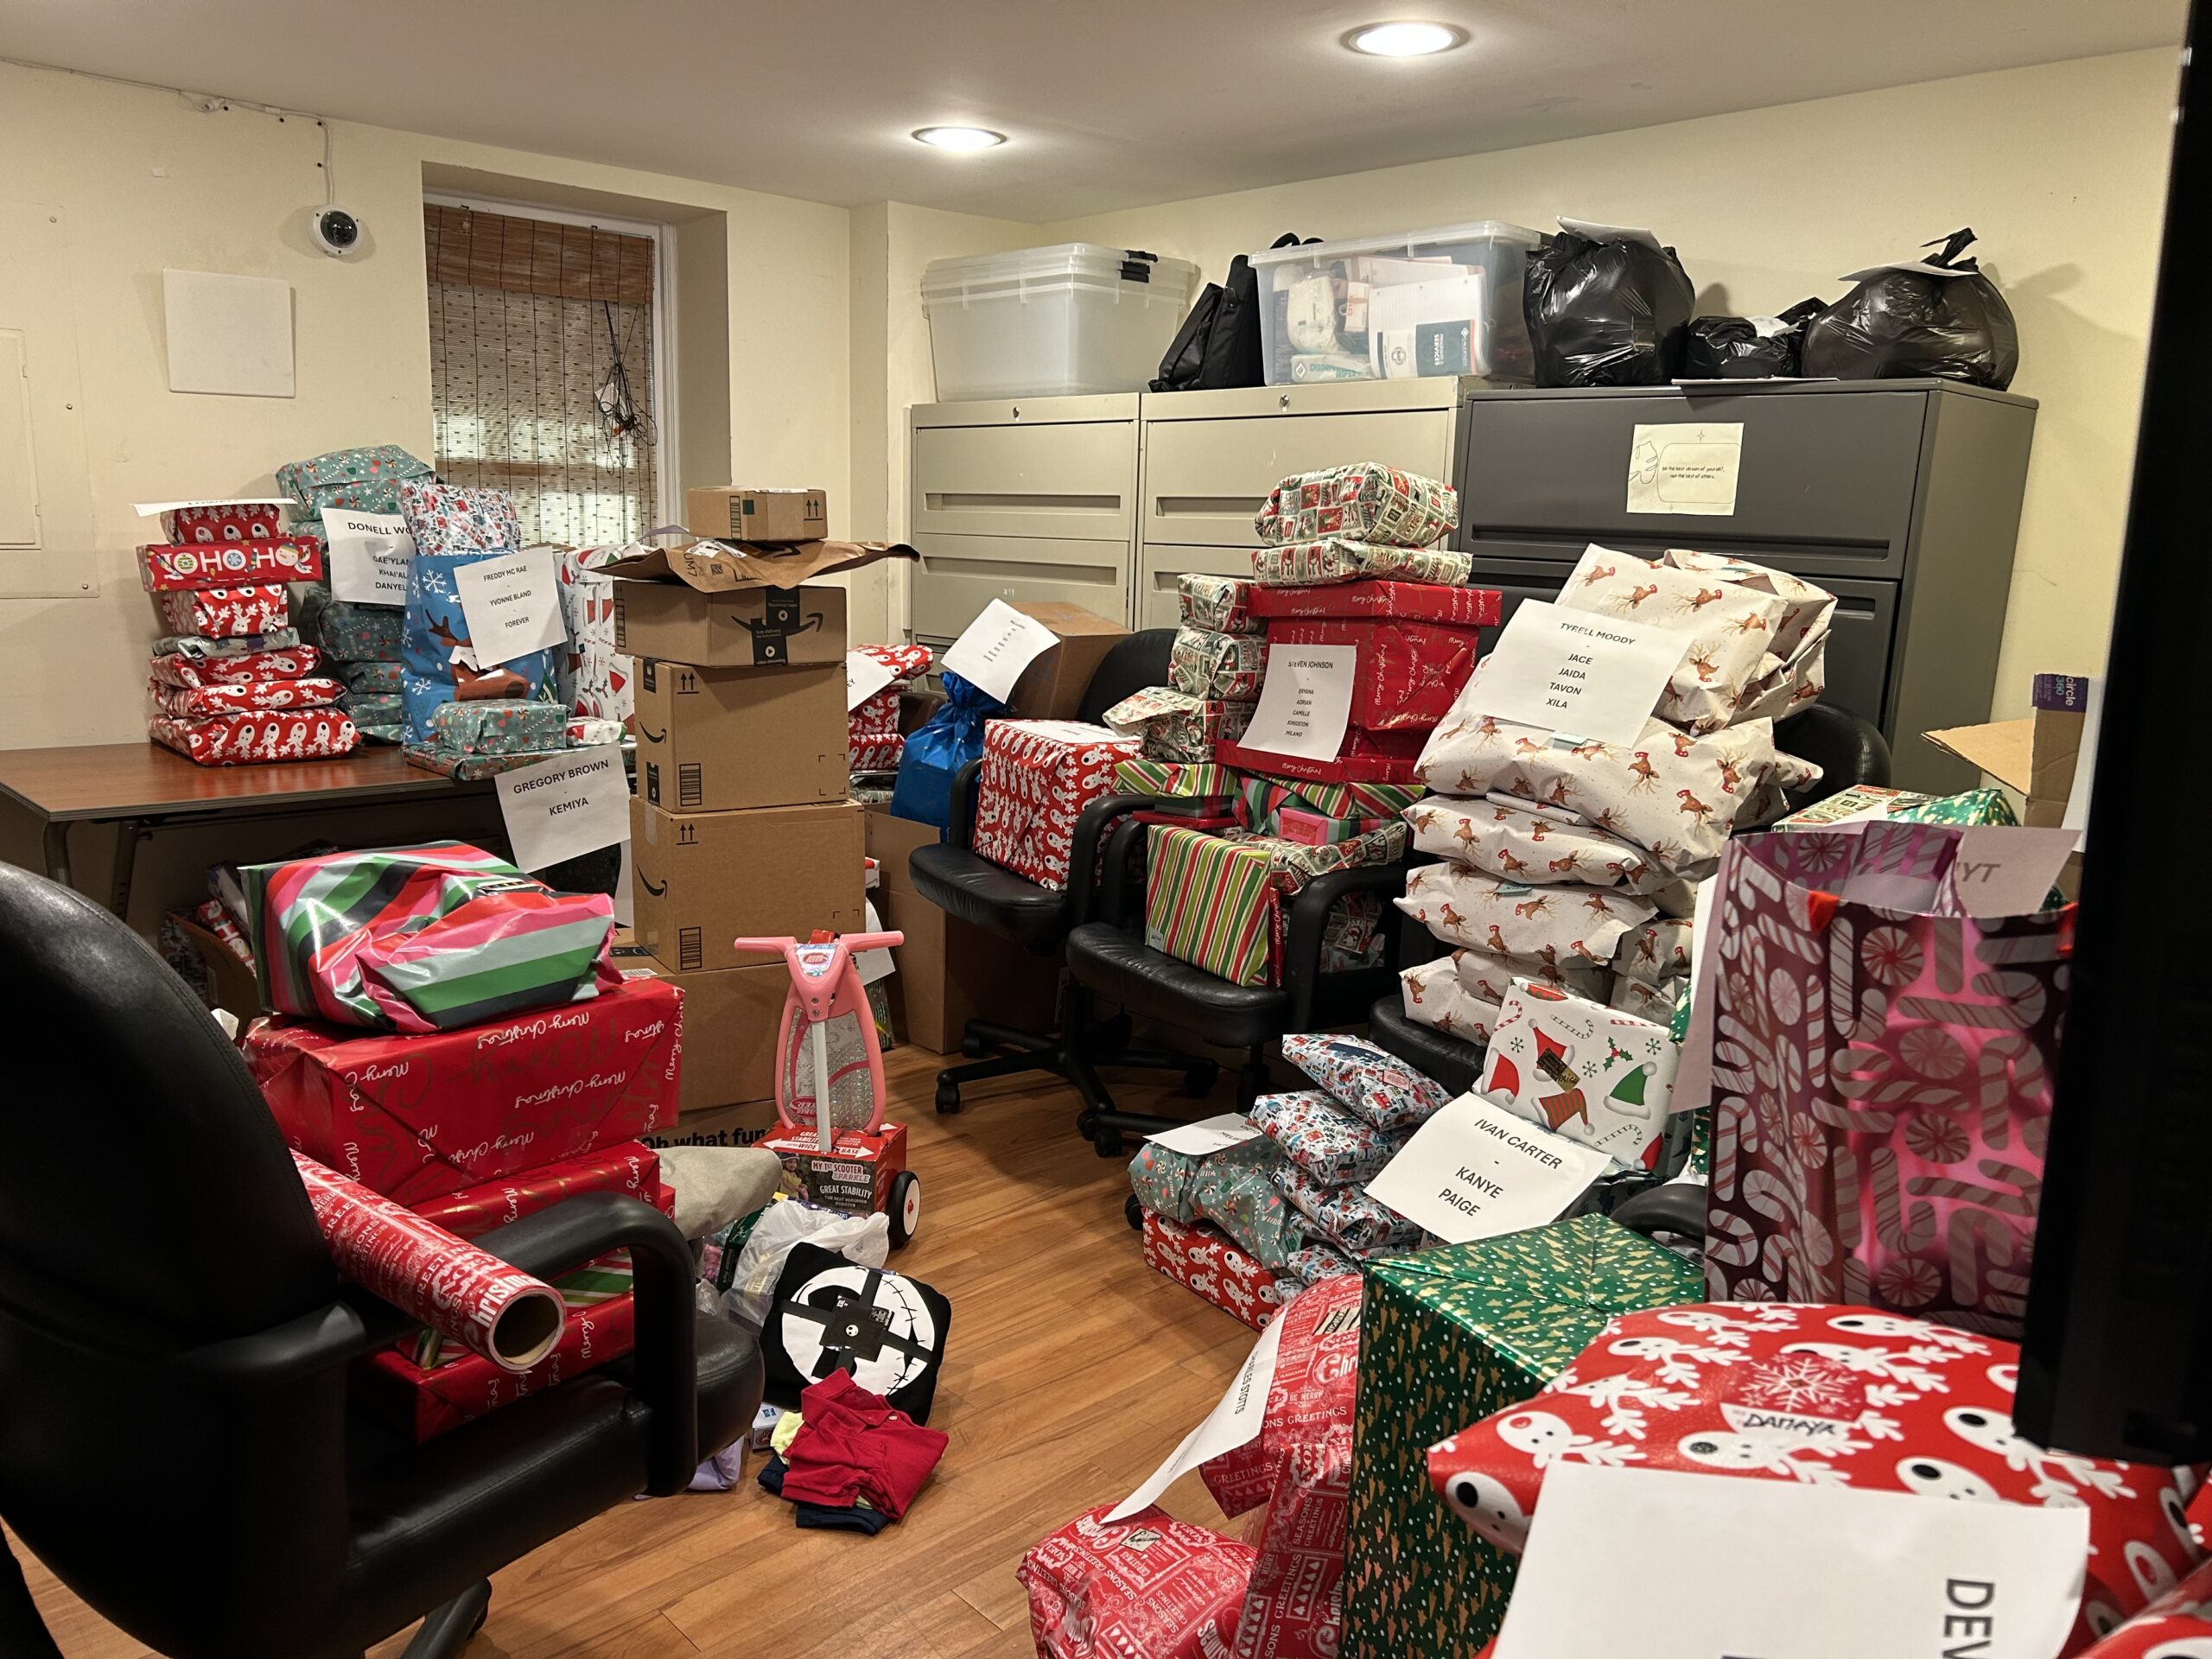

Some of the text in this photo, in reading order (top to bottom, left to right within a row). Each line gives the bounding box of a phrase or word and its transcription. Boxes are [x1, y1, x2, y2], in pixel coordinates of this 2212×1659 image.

[347, 522, 392, 536] DONELL
[483, 565, 528, 582] FREDDY MC RAE
[490, 590, 532, 607] YVONNE BLAND
[505, 616, 530, 629] FOREVER
[1560, 622, 1637, 645] TYRELL MOODY
[1308, 661, 1333, 670] JOHNSON
[1567, 653, 1593, 665] JACE
[1558, 667, 1586, 680] JAIDA
[1375, 679, 1384, 706] Merry
[1548, 681, 1582, 696] TAVON
[2056, 677, 2065, 696] 360
[2065, 677, 2077, 707] circle
[1545, 697, 1567, 709] XILA
[513, 760, 609, 794] GREGORY BROWN
[549, 797, 589, 817] KEMIYA
[1957, 862, 2001, 883] YT
[477, 1012, 590, 1050] Merry Christmas
[514, 1071, 626, 1109] Merry Christmas
[491, 1132, 535, 1150] Merry
[640, 1135, 670, 1148] Oh
[674, 1129, 728, 1147] what
[1474, 1118, 1563, 1169] IVAN CARTER
[624, 1155, 640, 1191] Merry
[812, 1162, 823, 1171] MY
[834, 1163, 862, 1174] SCOOTER
[833, 1173, 869, 1183] SPARKLE
[819, 1185, 873, 1199] GREAT STABILITY
[1455, 1166, 1503, 1199] KANYE
[1438, 1187, 1481, 1217] PAIGE
[1235, 1383, 1250, 1415] STOTTS
[1287, 1406, 1347, 1425] GREETINGS
[1212, 1461, 1274, 1485] GREETINGS
[1292, 1497, 1313, 1547] SEASONS
[1303, 1497, 1324, 1548] GREETINGS
[1072, 1545, 1107, 1572] GREETINGS
[1104, 1569, 1138, 1601] SEASONS
[1274, 1554, 1303, 1619] GREETINGS
[1147, 1597, 1179, 1634] SEASONS
[1154, 1589, 1187, 1625] GREETINGS
